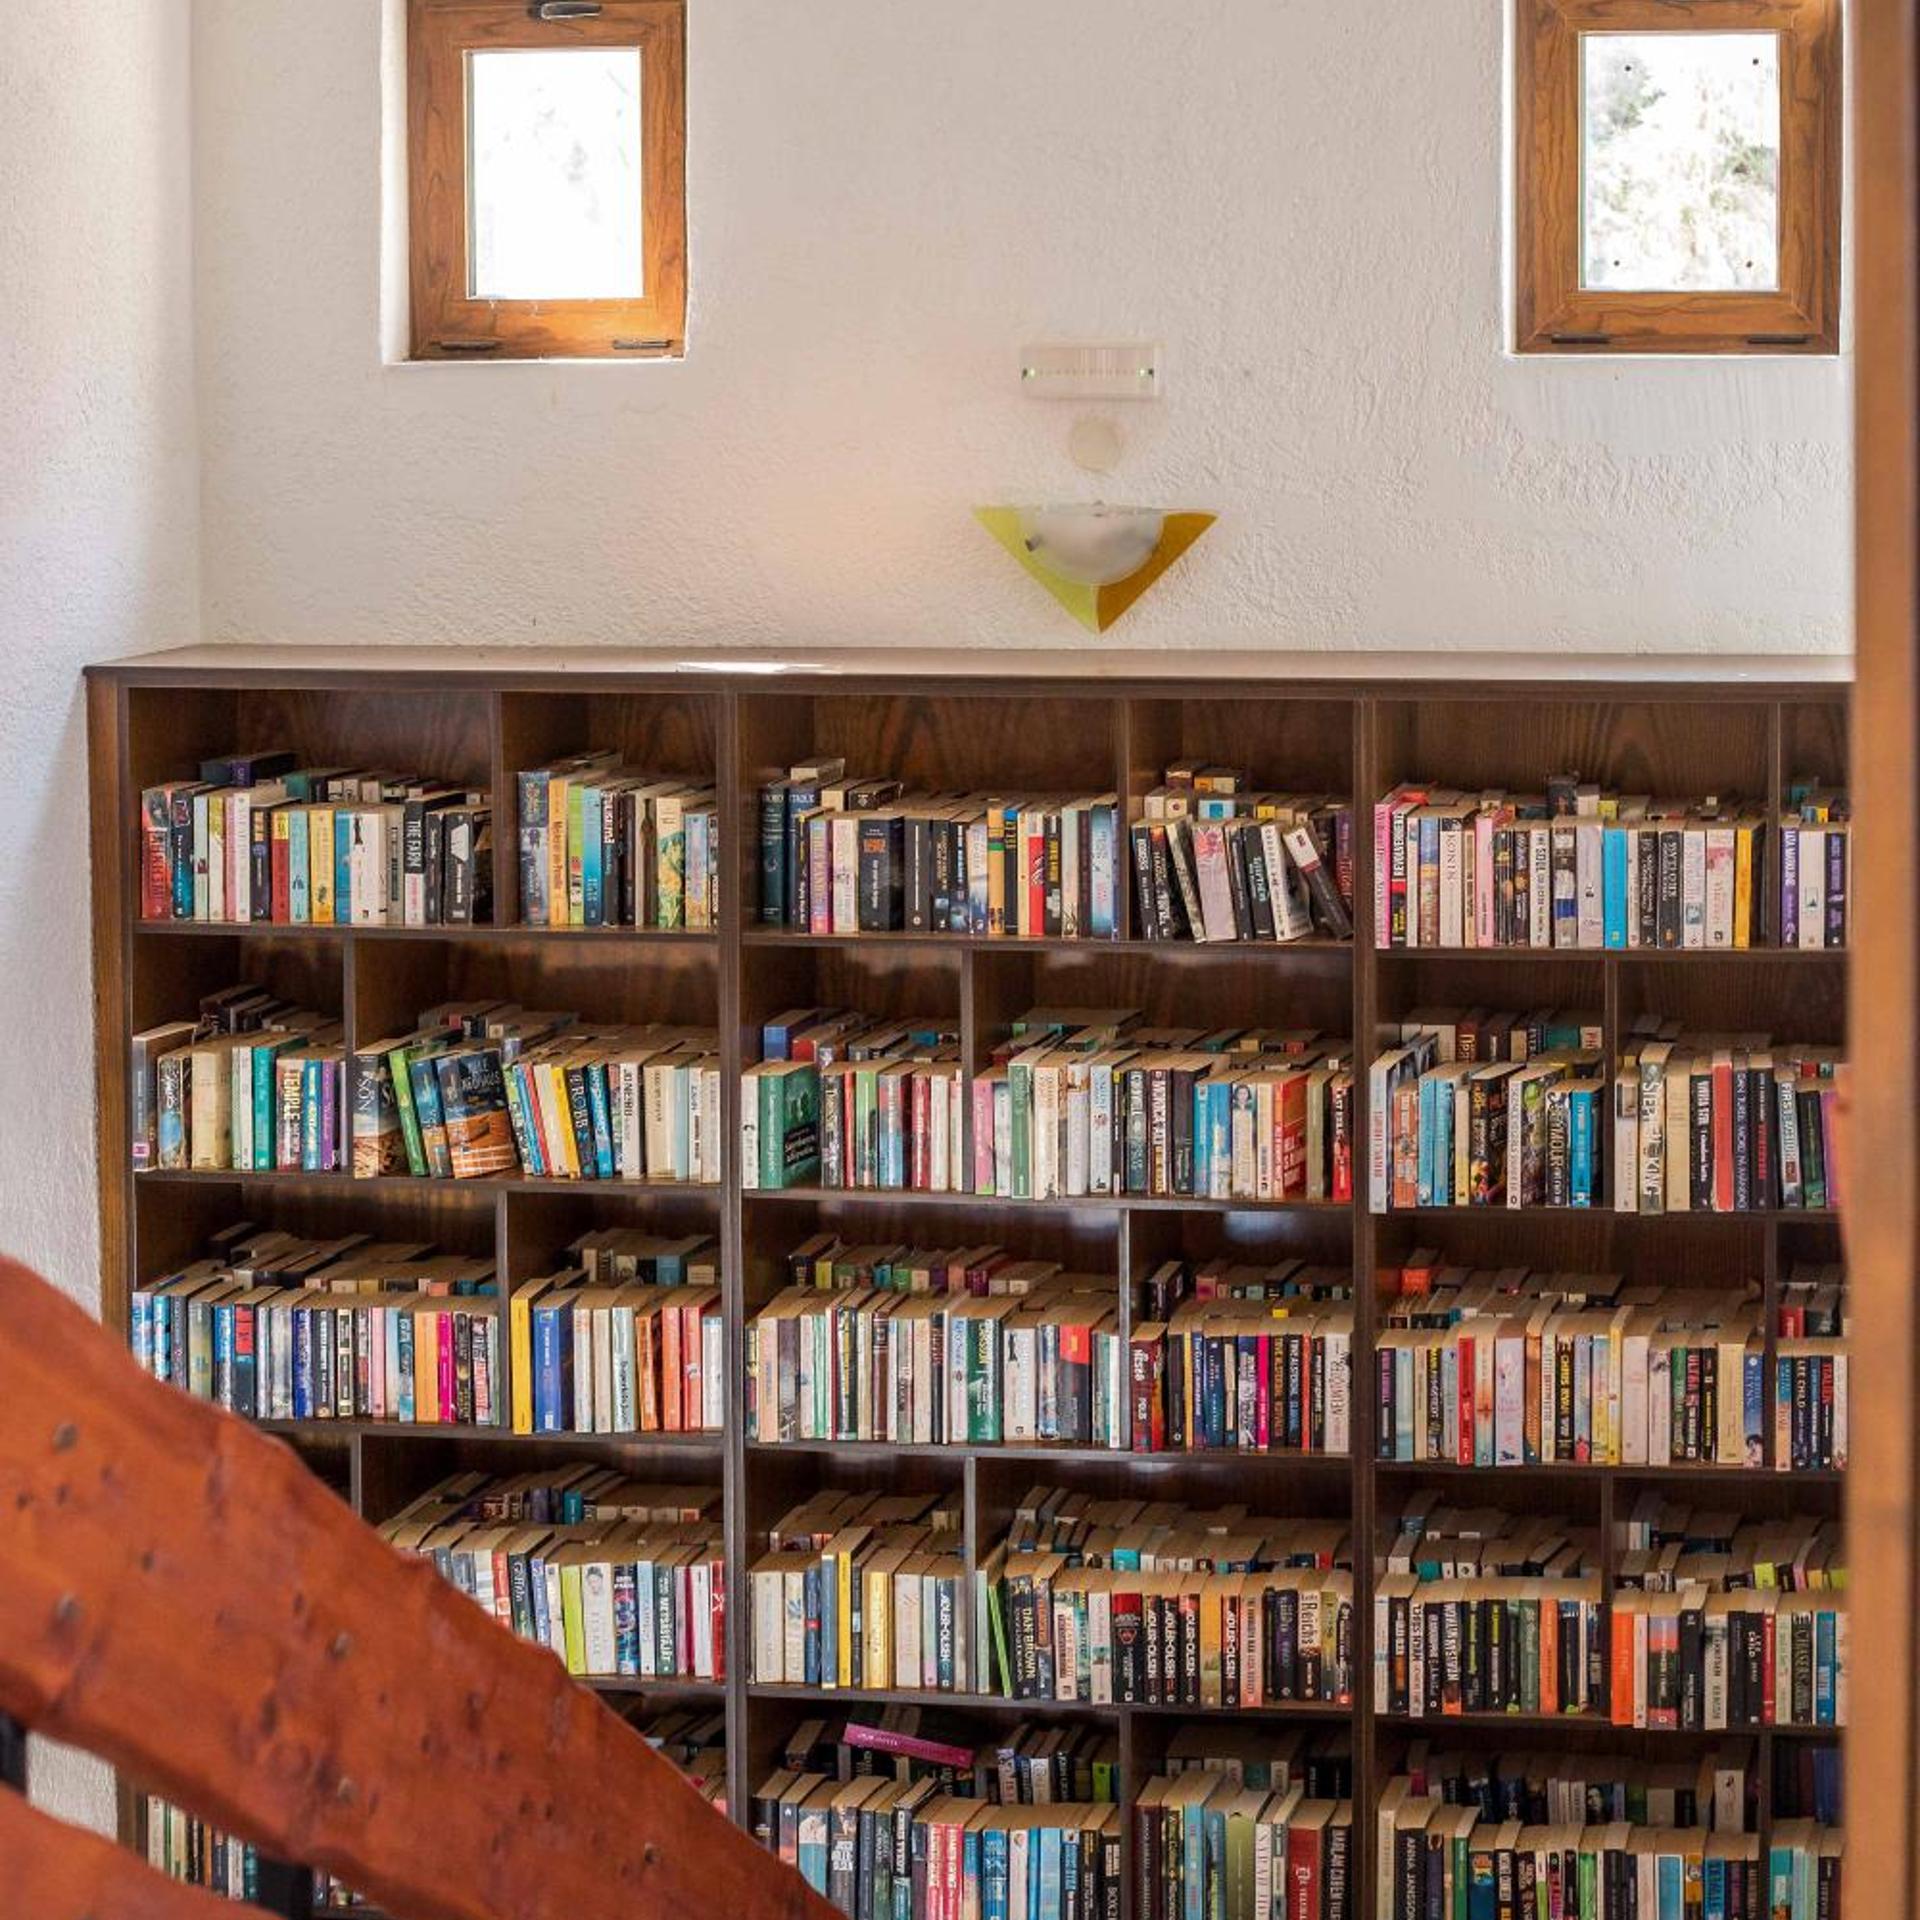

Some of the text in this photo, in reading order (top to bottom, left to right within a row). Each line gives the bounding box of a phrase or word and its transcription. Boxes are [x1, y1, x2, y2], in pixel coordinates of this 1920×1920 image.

[407, 820, 421, 868] THE FARM
[1784, 848, 1796, 887] MARKLUND
[283, 1071, 301, 1120] TEMPLE
[358, 1078, 372, 1111] SON
[1152, 1080, 1166, 1123] MONICA
[1642, 1081, 1664, 1195] STEPHEN KING
[1134, 1349, 1145, 1382] NESBØ
[1560, 1354, 1570, 1385] CHRIS
[1797, 1360, 1806, 1408] LEE CHILD
[940, 1592, 952, 1662] ADLER-OLSEN
[1021, 1607, 1036, 1679] DAN BROWN
[1147, 1609, 1158, 1679] ADLER-OLSEN
[1164, 1610, 1176, 1680] ADLER-OLSEN
[1185, 1609, 1196, 1678] ADLER-OLSEN
[1225, 1609, 1236, 1680] ADLER-OLSEN
[1300, 1602, 1318, 1645] Reichs
[1747, 1631, 1755, 1658] CHILD
[1406, 1837, 1416, 1871] ANNA
